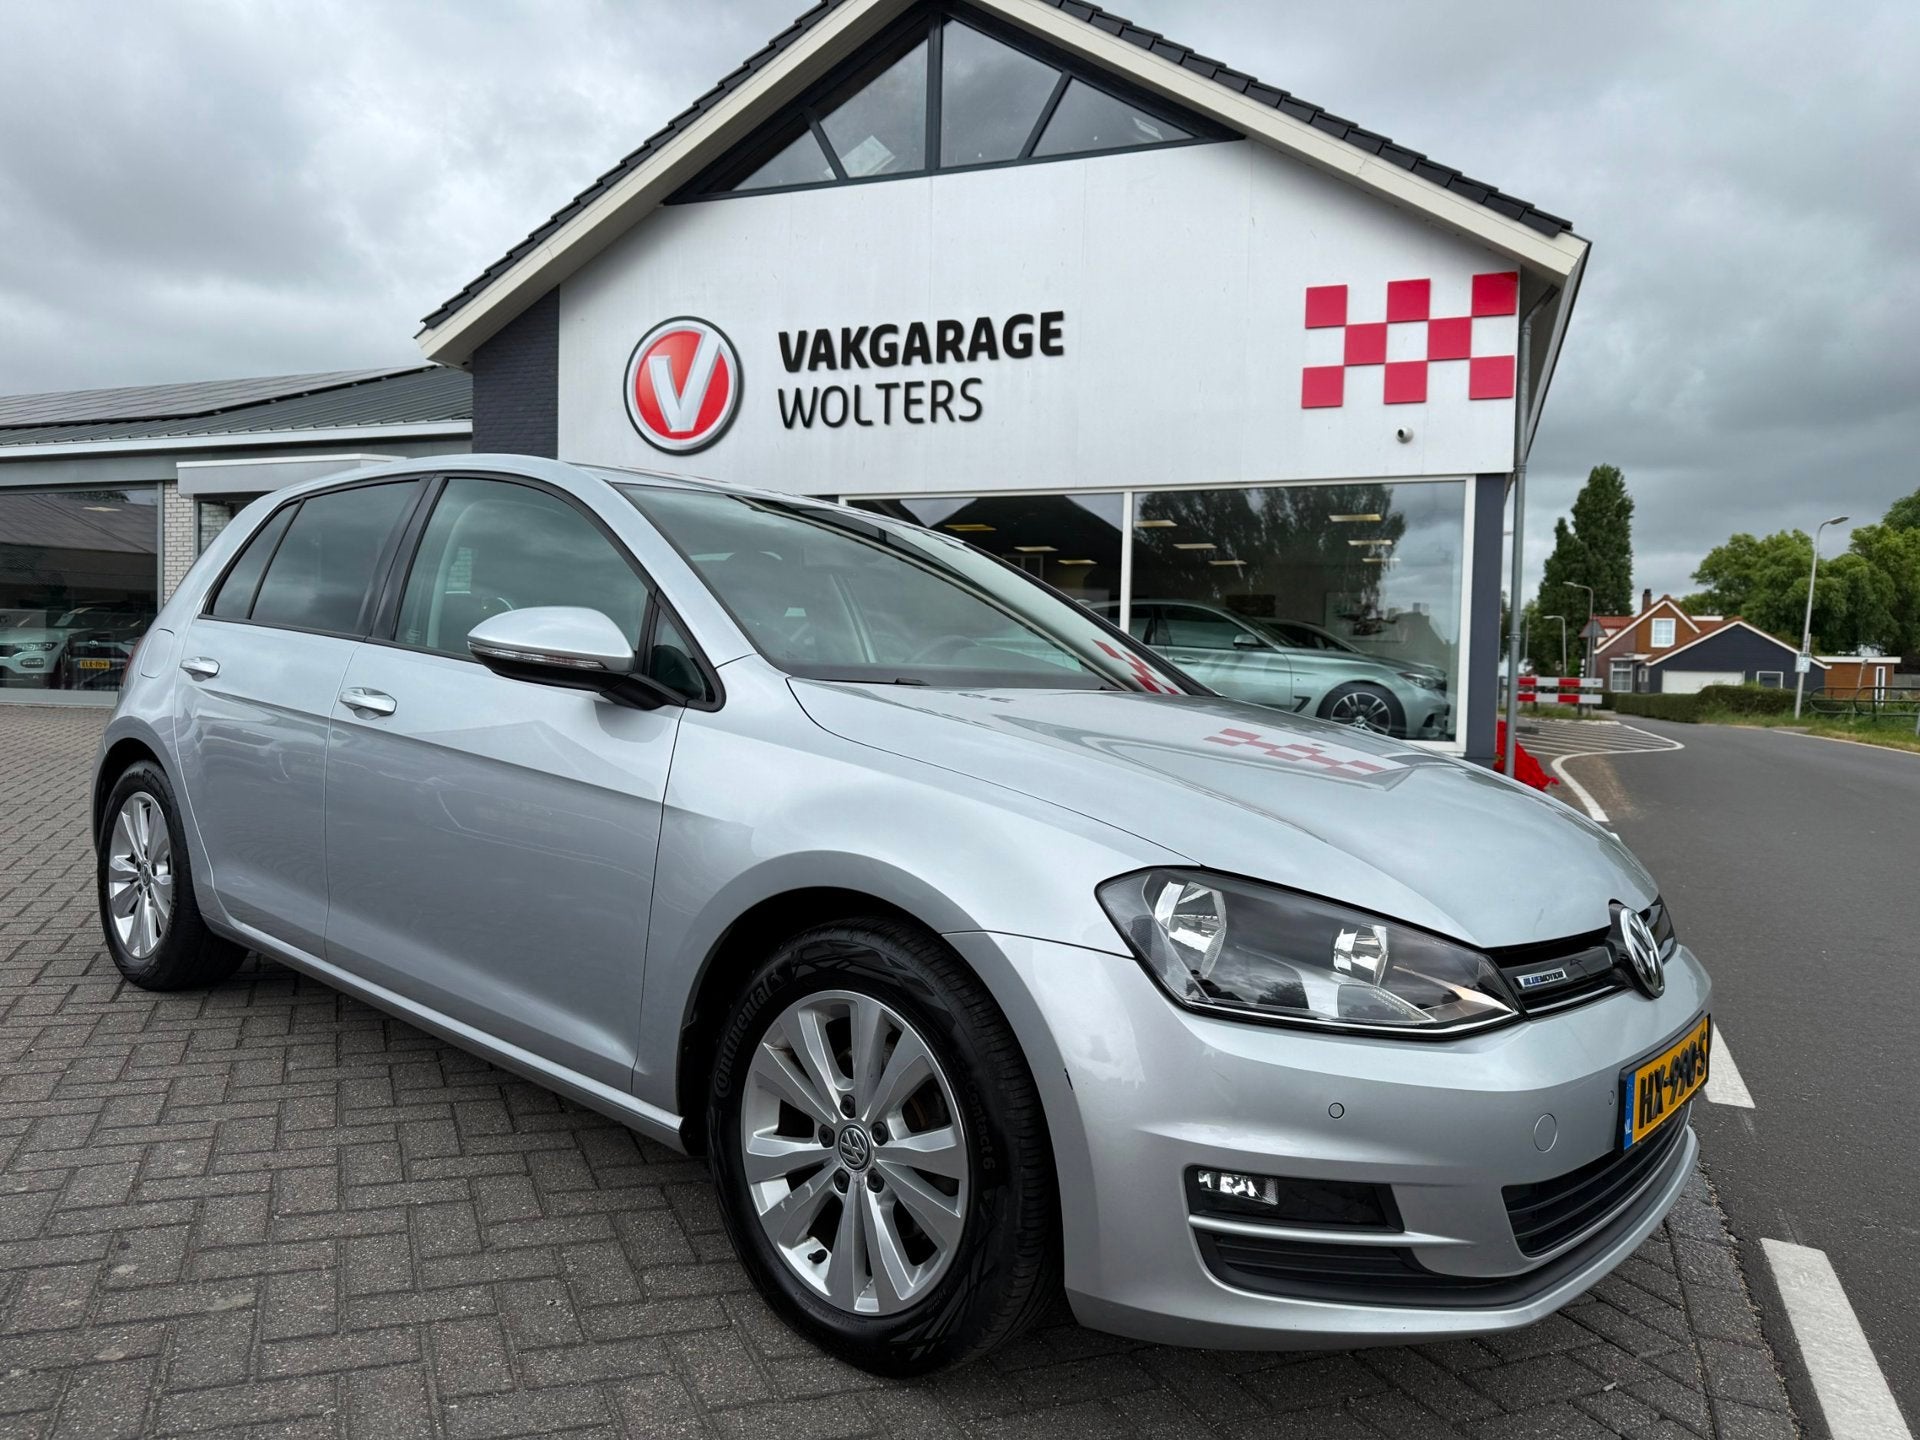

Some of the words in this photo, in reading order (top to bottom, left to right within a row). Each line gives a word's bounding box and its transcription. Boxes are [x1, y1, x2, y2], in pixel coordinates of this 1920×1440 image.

[777, 310, 1065, 373] VAKGARAGE
[777, 377, 984, 430] WOLTERS
[1523, 970, 1564, 986] BLUEMOTION
[713, 976, 774, 1099] Continental
